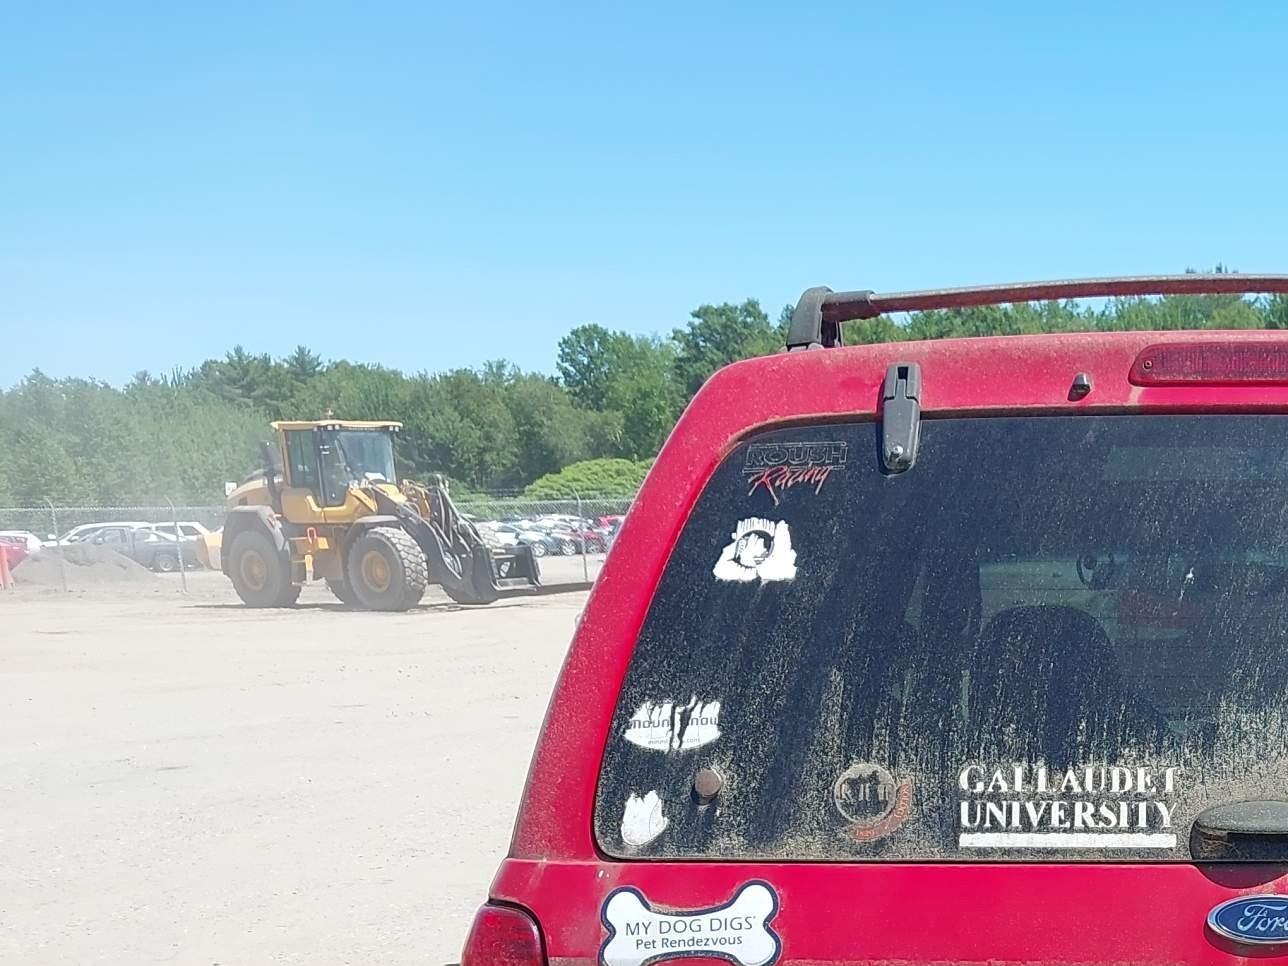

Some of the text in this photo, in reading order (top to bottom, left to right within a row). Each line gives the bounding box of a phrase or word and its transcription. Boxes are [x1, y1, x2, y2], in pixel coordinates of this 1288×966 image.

[745, 445, 848, 465] ROUSH
[748, 465, 832, 506] Racing
[959, 765, 1178, 793] GALLAUDET
[960, 800, 1178, 828] UNIVERSITY
[625, 921, 652, 937] MY
[659, 919, 702, 935] DOG
[635, 935, 743, 950] Pet Rendezvous
